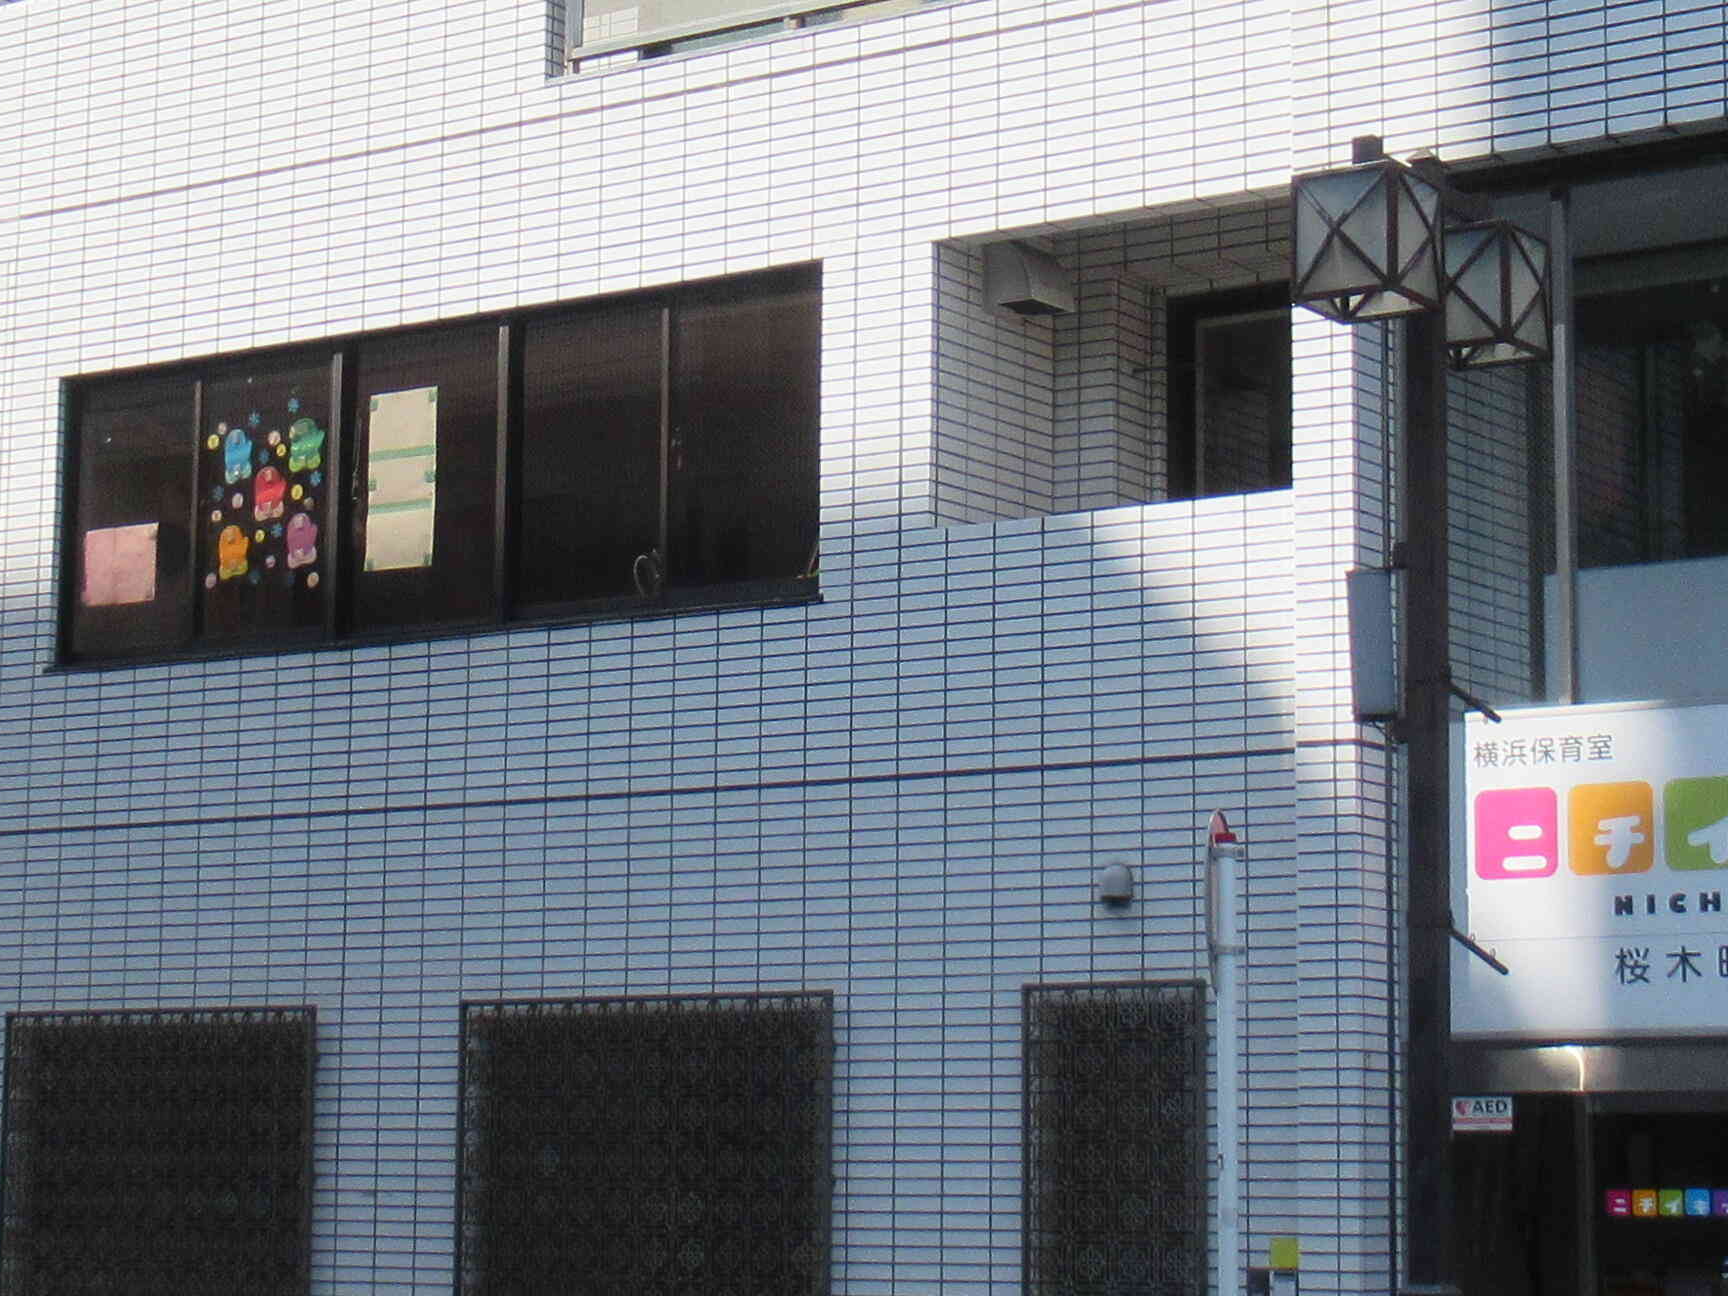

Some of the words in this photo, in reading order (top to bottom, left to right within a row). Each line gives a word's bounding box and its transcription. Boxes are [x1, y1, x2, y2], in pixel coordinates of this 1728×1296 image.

[1473, 734, 1614, 768] 横浜保育室
[1472, 1100, 1508, 1114] AED
